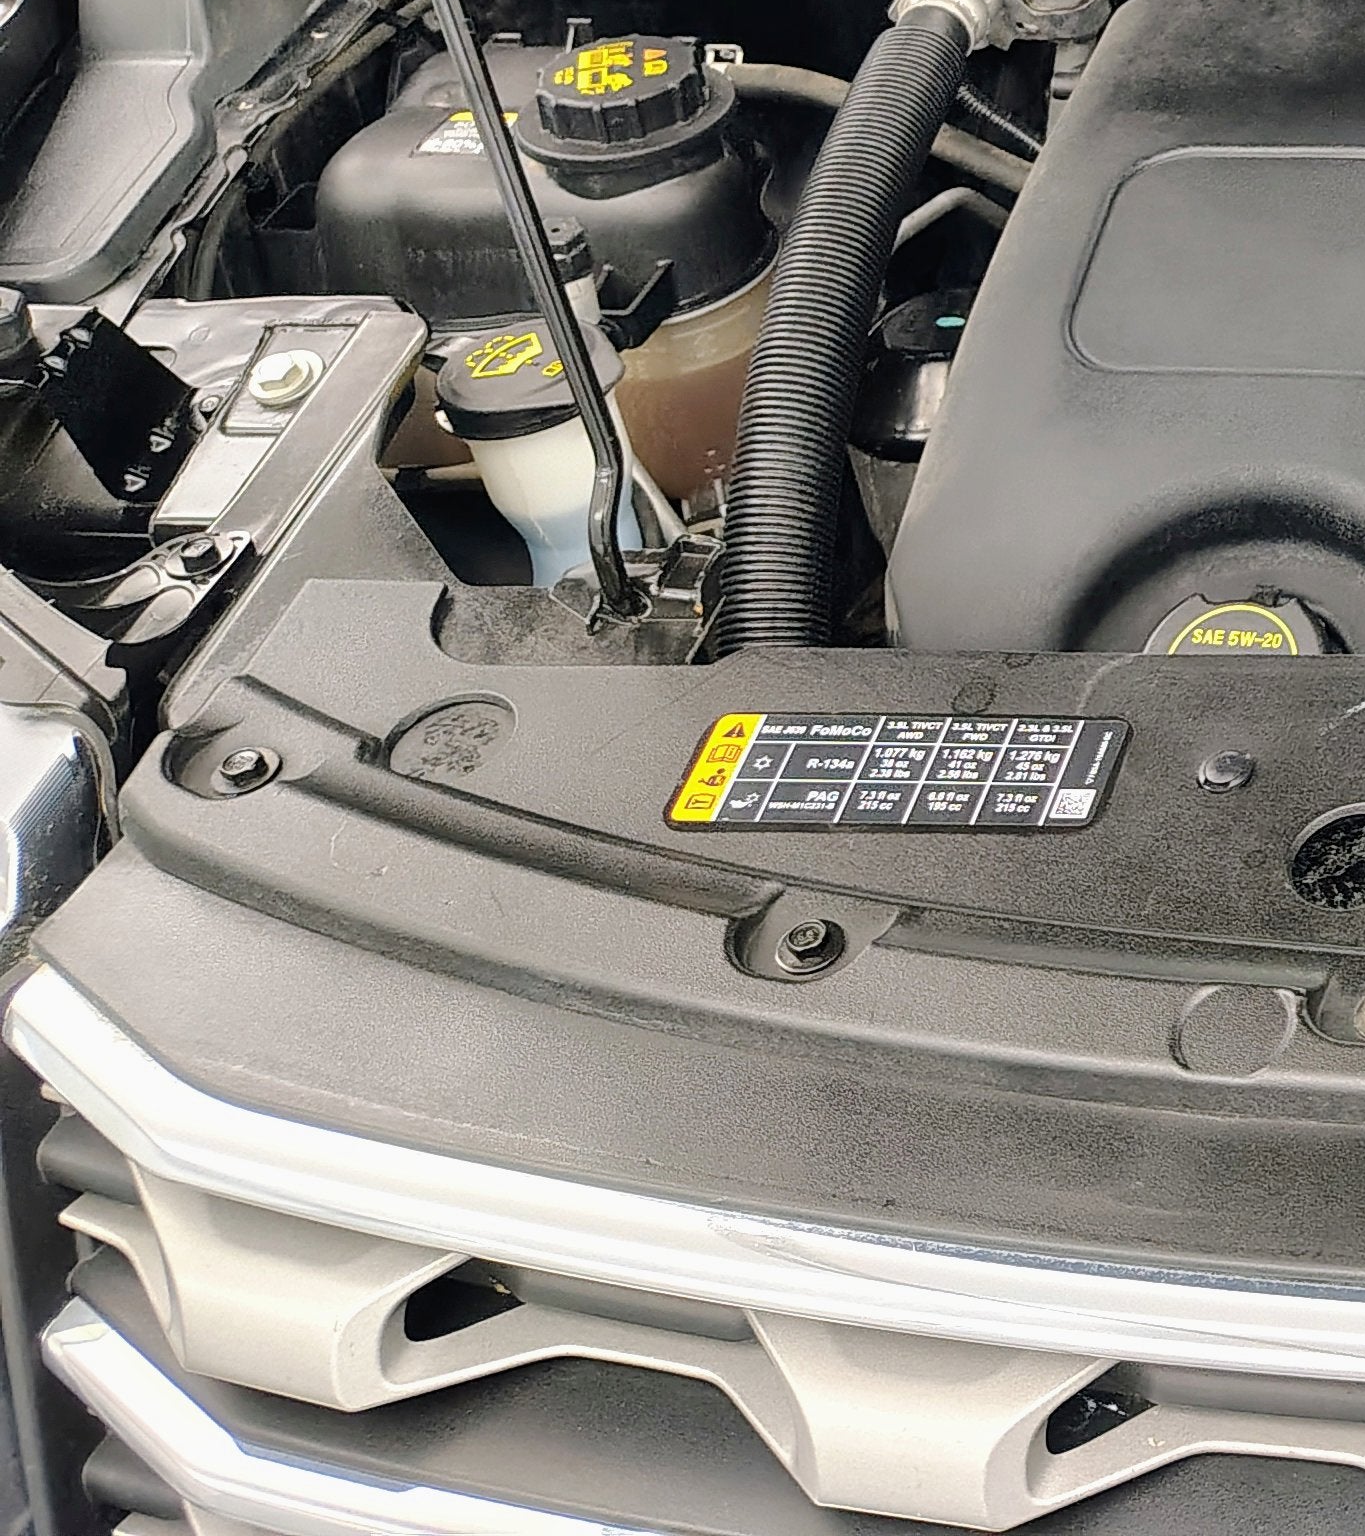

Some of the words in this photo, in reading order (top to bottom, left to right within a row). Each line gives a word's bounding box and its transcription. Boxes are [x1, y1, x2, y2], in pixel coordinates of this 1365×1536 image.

[1191, 628, 1226, 645] SAE
[1228, 630, 1283, 649] 5W-20
[761, 724, 782, 734] SAE
[809, 724, 873, 737] FoMoCo
[896, 731, 924, 740] AWD
[961, 732, 989, 742] FWD
[874, 747, 908, 759] 1.077
[908, 747, 926, 762] kg
[975, 749, 994, 763] kg
[1008, 749, 1043, 762] 1.276
[1043, 750, 1061, 764] kg
[805, 757, 856, 770] R-134a
[895, 760, 910, 769] oz
[946, 760, 962, 770] 41
[963, 761, 978, 770] oz
[1031, 763, 1046, 772] oz
[893, 769, 911, 779] lbs
[961, 770, 980, 780] lbs
[1029, 771, 1047, 781] lbs
[805, 790, 841, 802] PAG
[859, 790, 877, 800] 7.3
[886, 792, 902, 801] oz
[955, 793, 971, 802] oz
[996, 792, 1014, 803] 7.3
[1023, 795, 1040, 804] oz
[857, 800, 880, 811] 215
[879, 802, 894, 811] cc
[926, 801, 948, 811] 195
[947, 803, 963, 812] cc
[994, 802, 1016, 813] 215
[1015, 805, 1032, 813] cc
